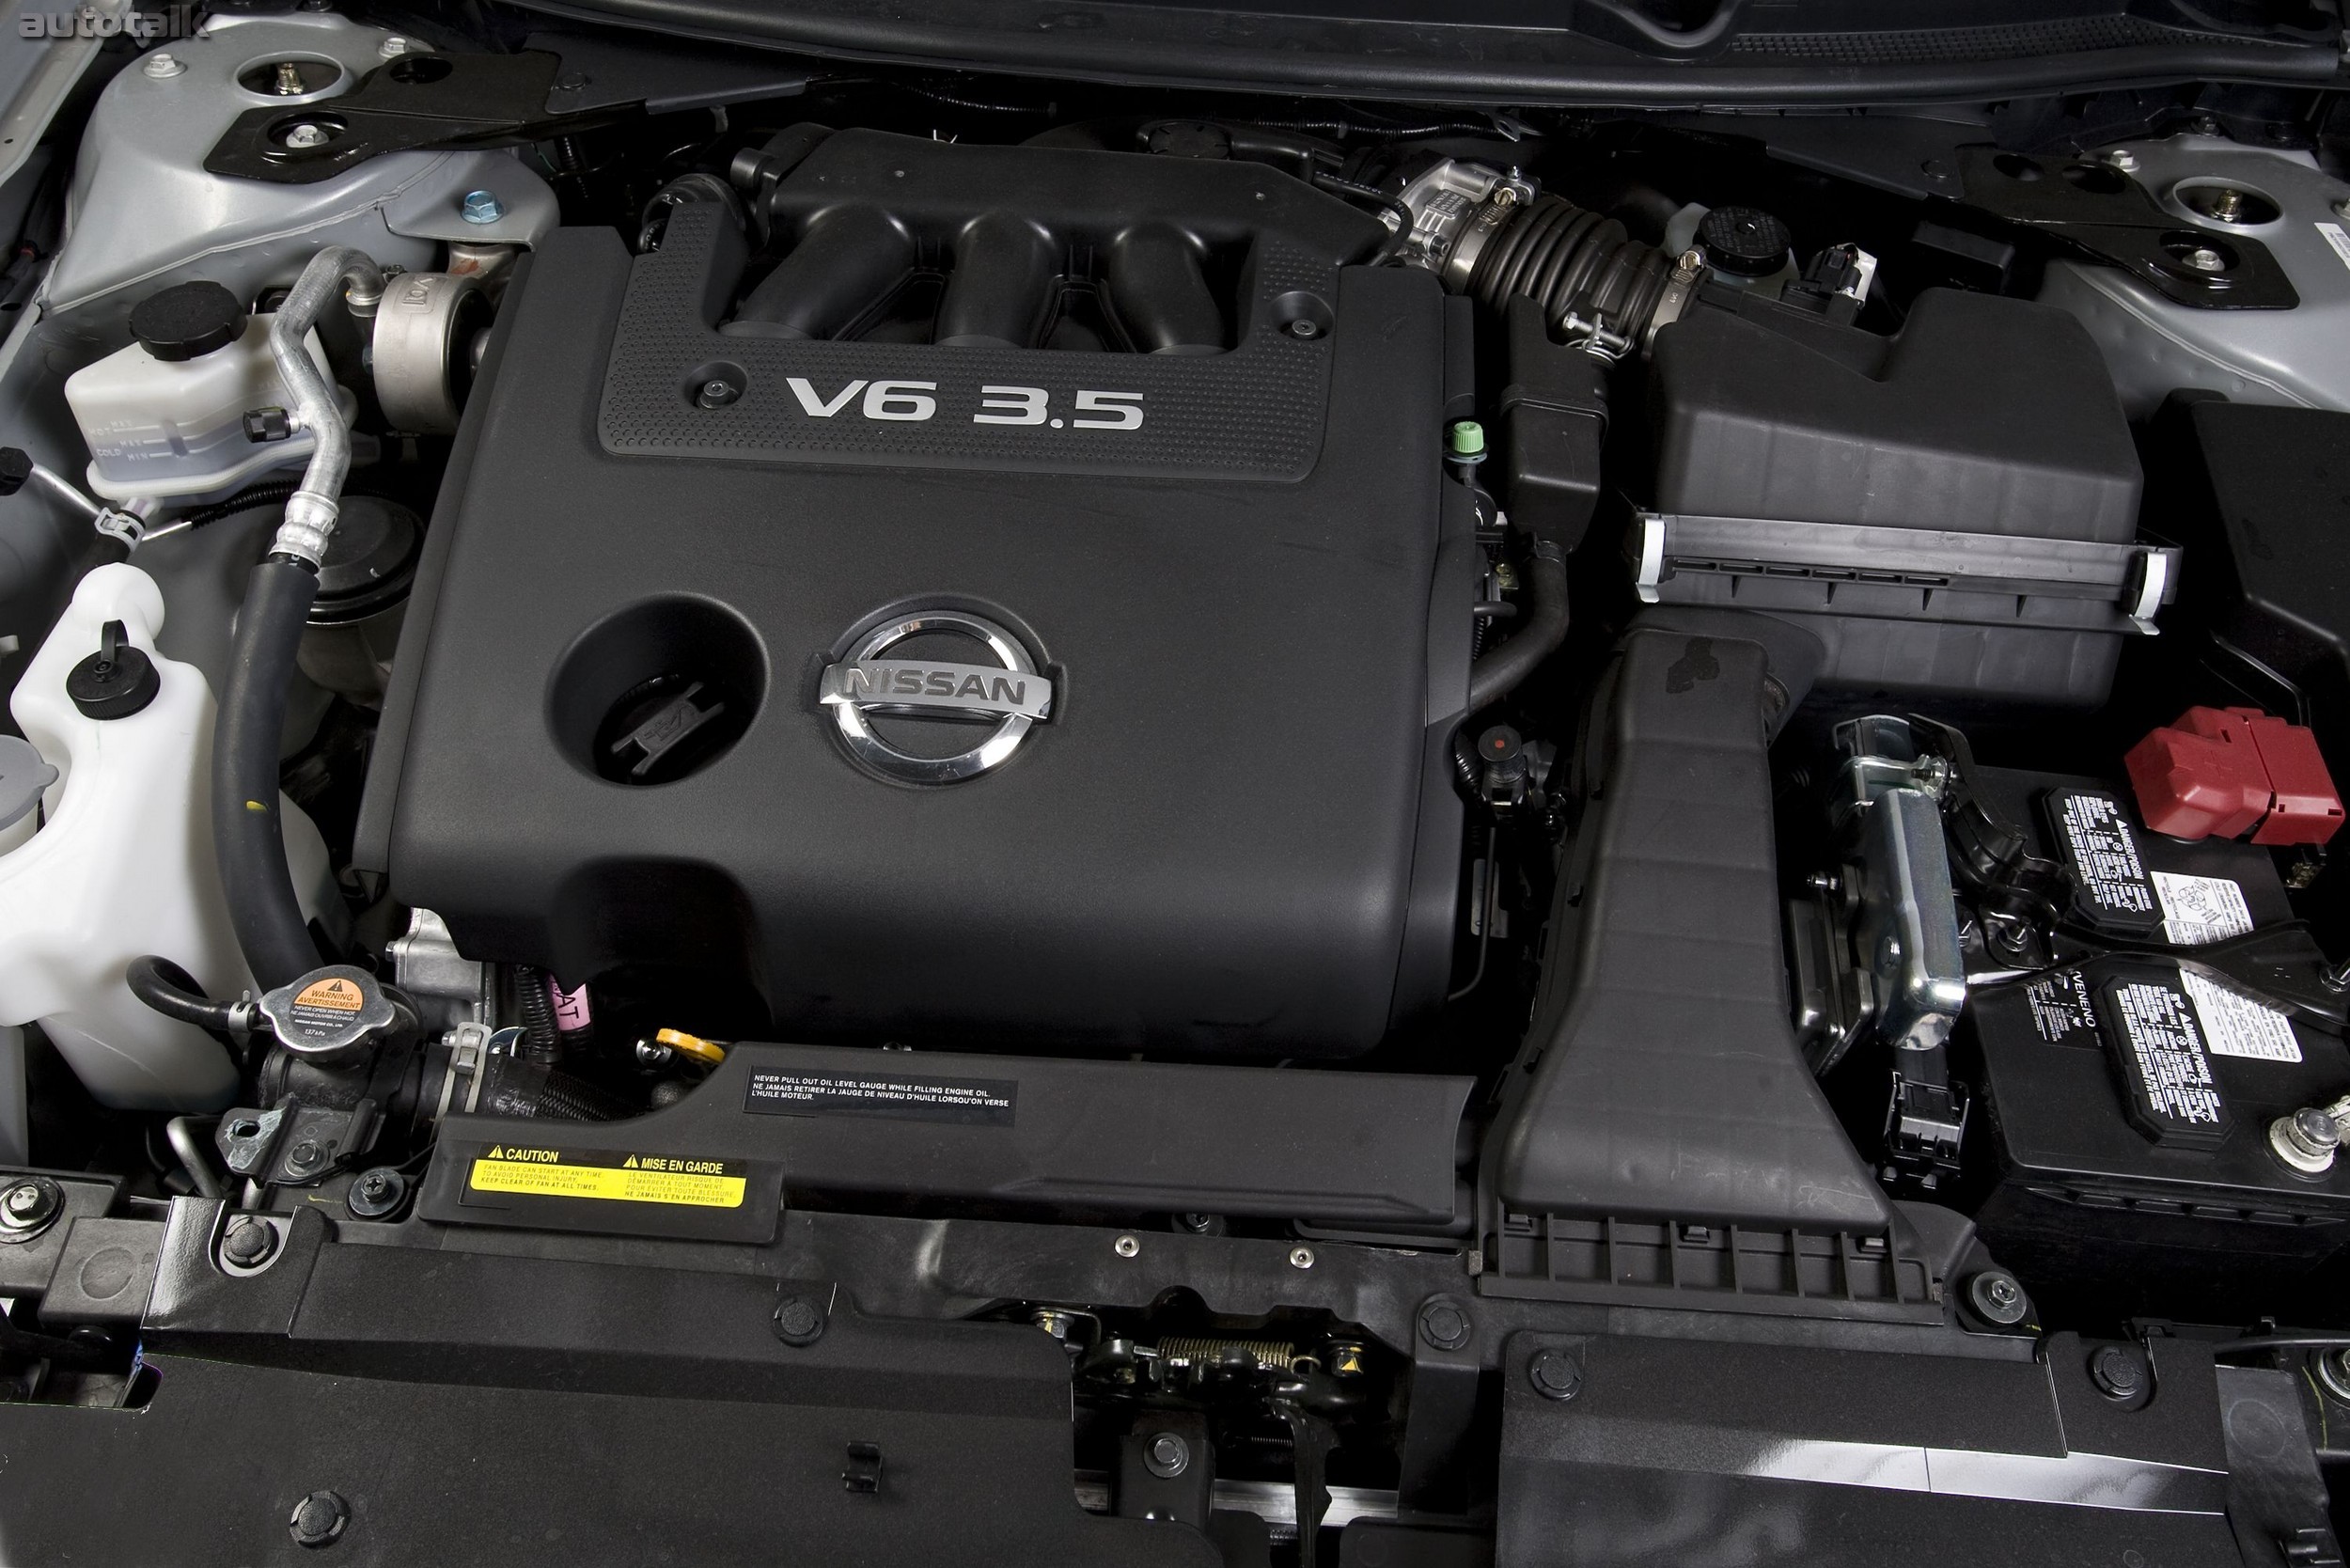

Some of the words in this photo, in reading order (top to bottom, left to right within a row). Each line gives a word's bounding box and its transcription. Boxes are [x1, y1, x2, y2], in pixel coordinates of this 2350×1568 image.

[786, 377, 937, 422] V6
[973, 385, 1144, 431] 3.5
[843, 667, 1026, 705] NISSAN
[298, 997, 360, 1009] AVERTISSEMENT
[311, 990, 354, 1000] WARNING
[754, 1074, 779, 1083] NEVER
[859, 1082, 886, 1090] GAUGE
[914, 1086, 943, 1094] FILLING
[945, 1088, 973, 1096] ENGINE
[781, 1091, 814, 1100] MOTEUR.
[838, 1089, 862, 1097] JAUGE
[907, 1093, 936, 1102] D'HUILE
[938, 1096, 982, 1105] LORSQU'ON
[984, 1099, 1009, 1107] VERSE
[506, 1148, 559, 1163] CAUTION
[641, 1157, 666, 1170] MISE
[668, 1160, 683, 1171] EN
[686, 1161, 724, 1174] GARDE
[682, 1195, 725, 1203] APPROCHER
